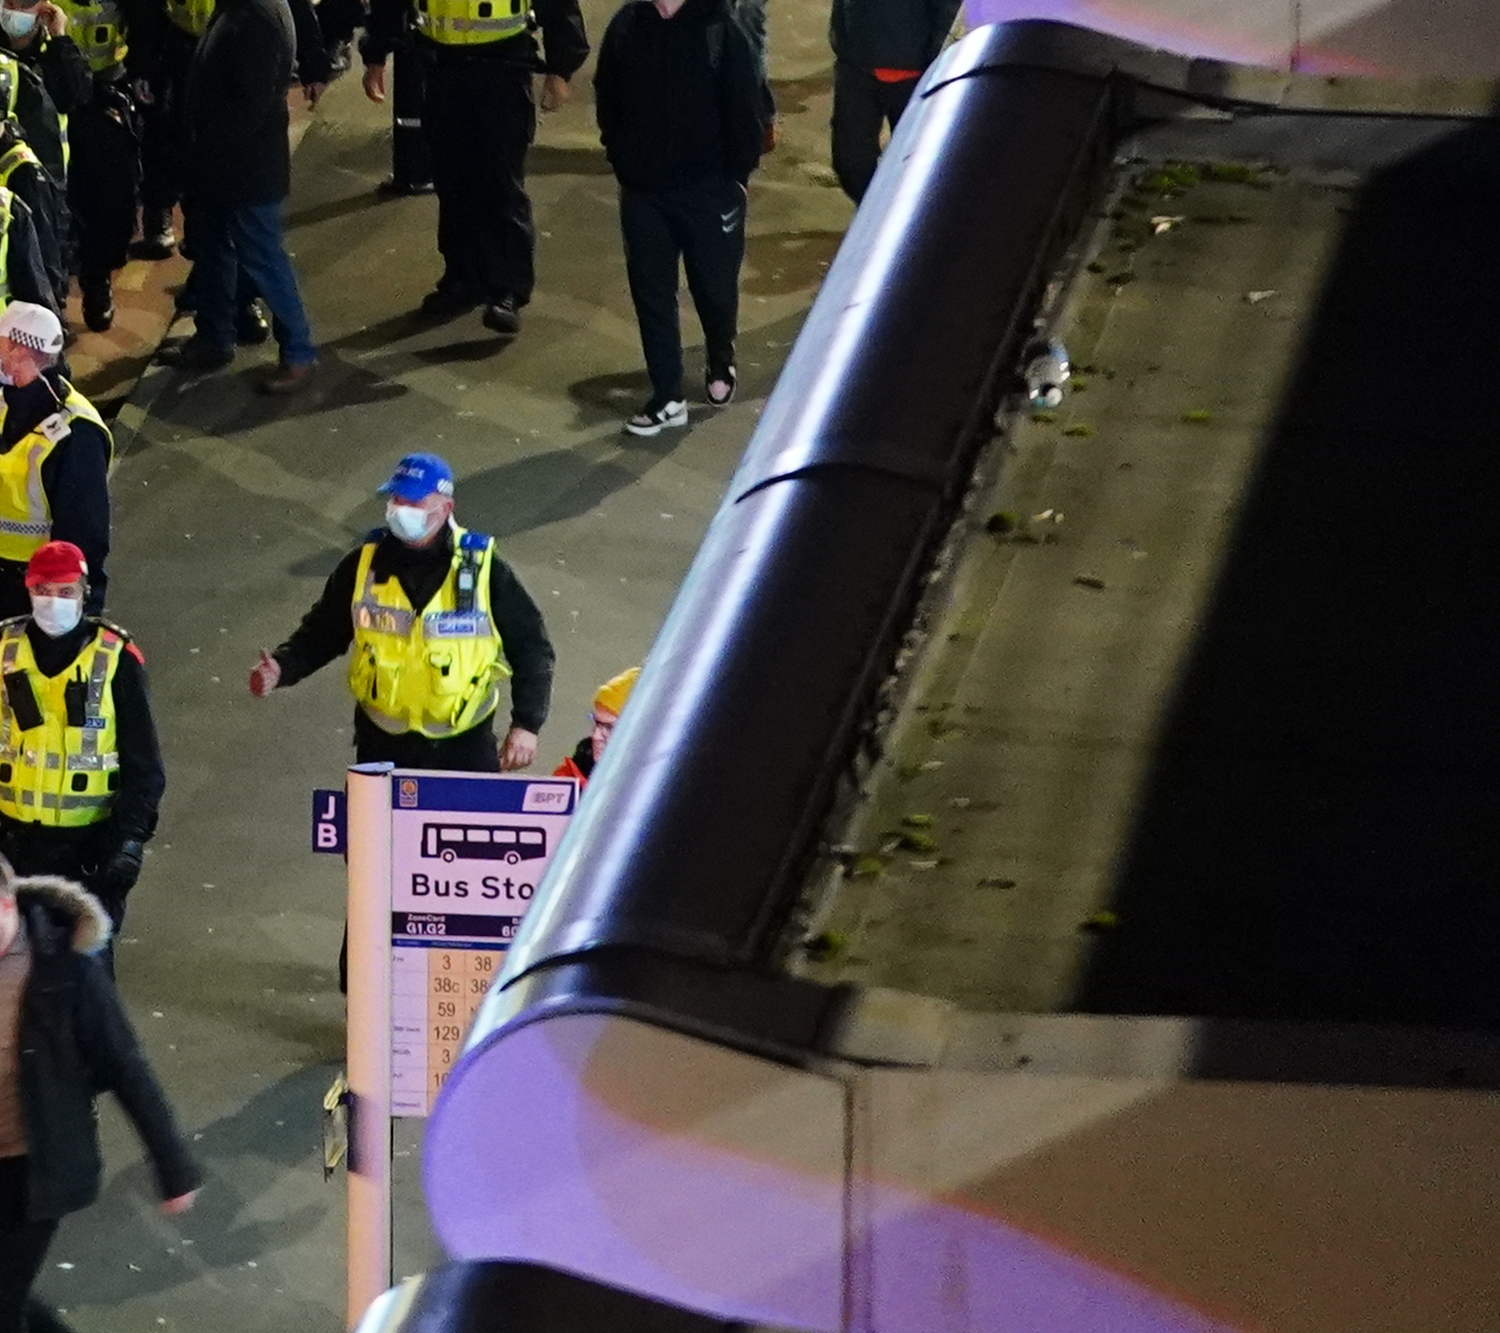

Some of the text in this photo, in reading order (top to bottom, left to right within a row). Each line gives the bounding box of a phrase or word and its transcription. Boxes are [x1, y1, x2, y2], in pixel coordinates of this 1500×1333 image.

[322, 796, 335, 820] J
[317, 824, 338, 848] B
[411, 874, 535, 900] Bus Sto
[442, 956, 492, 972] 3 38
[434, 978, 460, 993] 38c
[437, 1002, 456, 1017] 59
[434, 1026, 460, 1041] 129
[442, 1049, 451, 1064] 3
